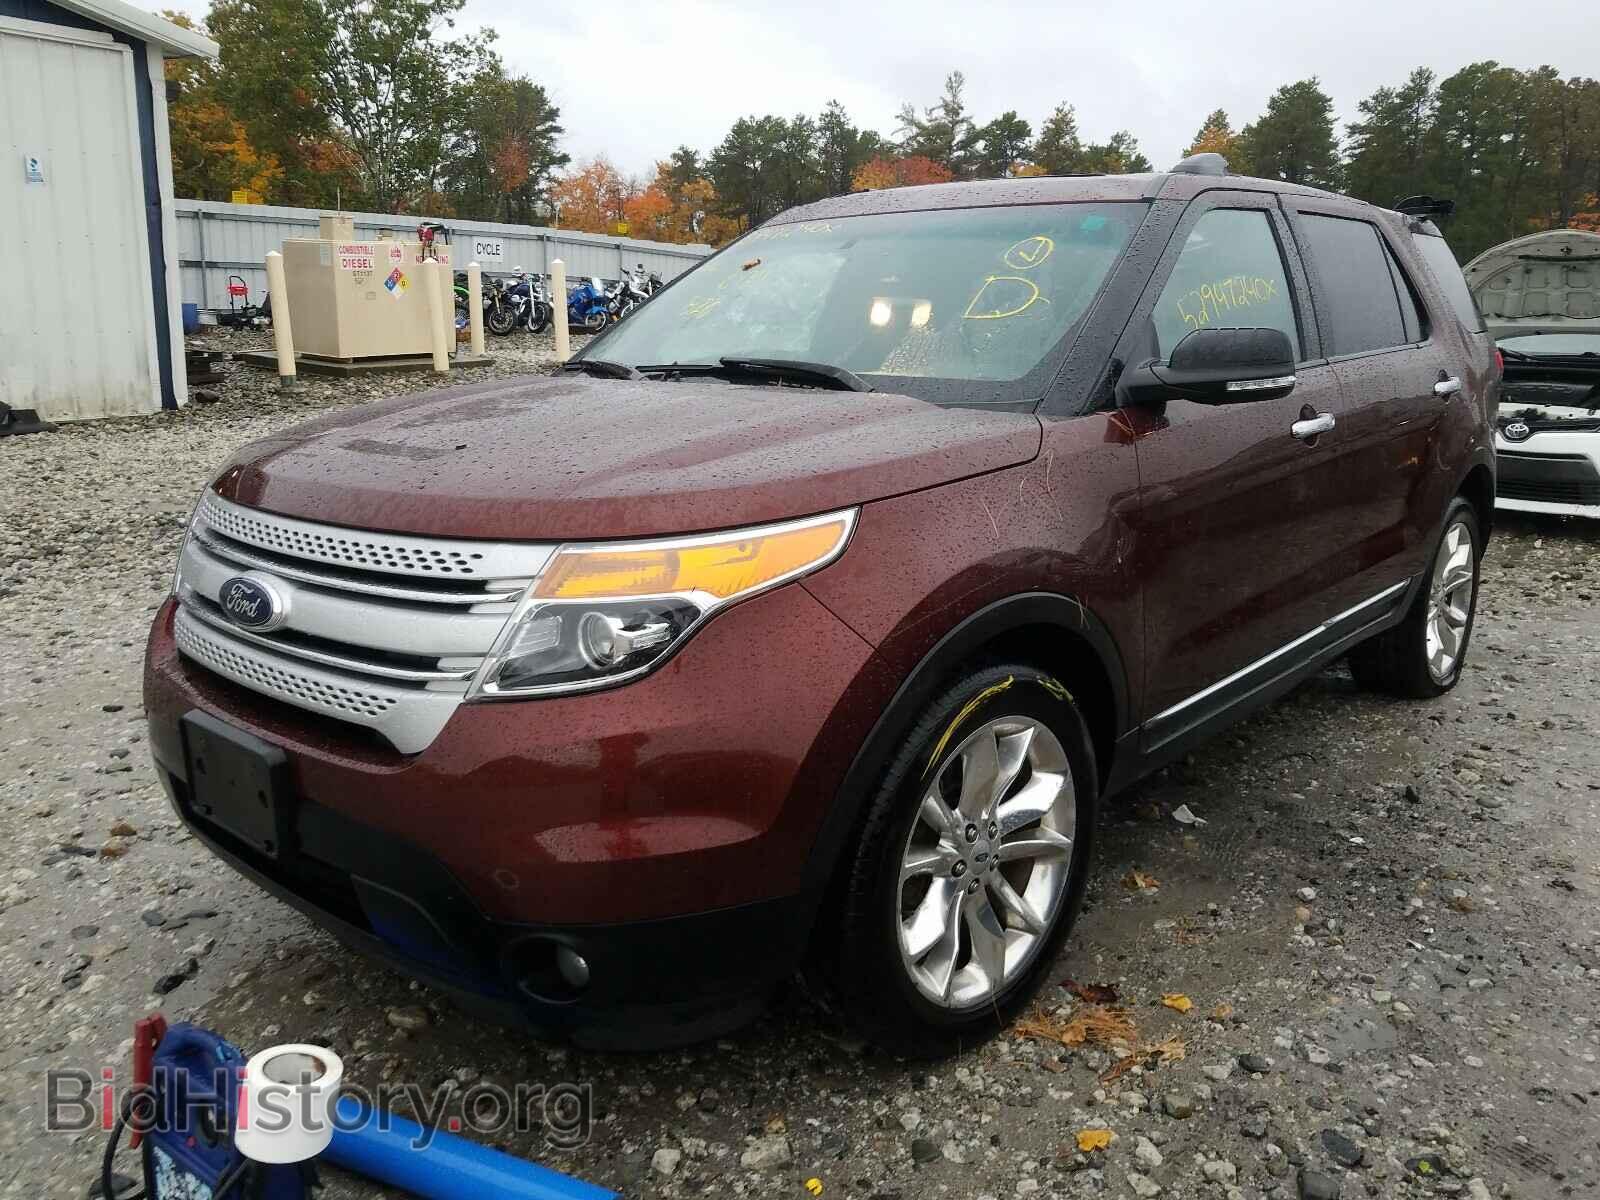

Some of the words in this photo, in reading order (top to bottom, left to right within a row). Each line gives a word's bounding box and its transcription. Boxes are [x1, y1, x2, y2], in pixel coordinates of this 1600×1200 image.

[338, 245, 374, 255] COMBUSTIBLE
[476, 243, 501, 256] CYCLE
[342, 258, 373, 269] DIESEL
[226, 583, 261, 618] Ford
